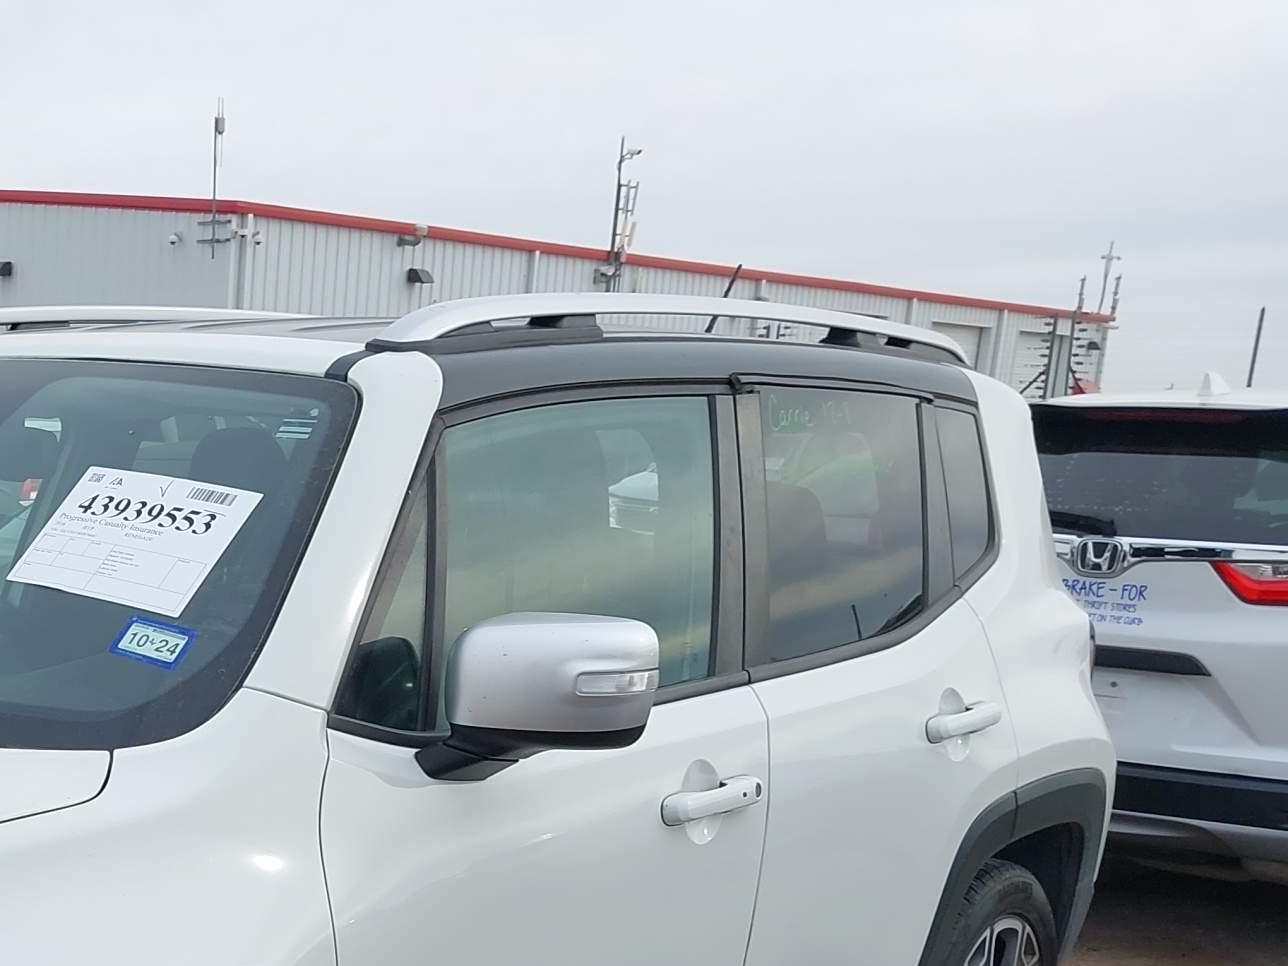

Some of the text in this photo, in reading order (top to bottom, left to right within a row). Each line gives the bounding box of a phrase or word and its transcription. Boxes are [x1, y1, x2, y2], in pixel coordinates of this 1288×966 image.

[60, 512, 98, 525] Progressive
[99, 518, 128, 531] Casualty
[130, 522, 164, 536] Insurance
[78, 494, 217, 535] 43939553
[1062, 578, 1107, 598] BRAKE
[1120, 583, 1149, 601] FOR
